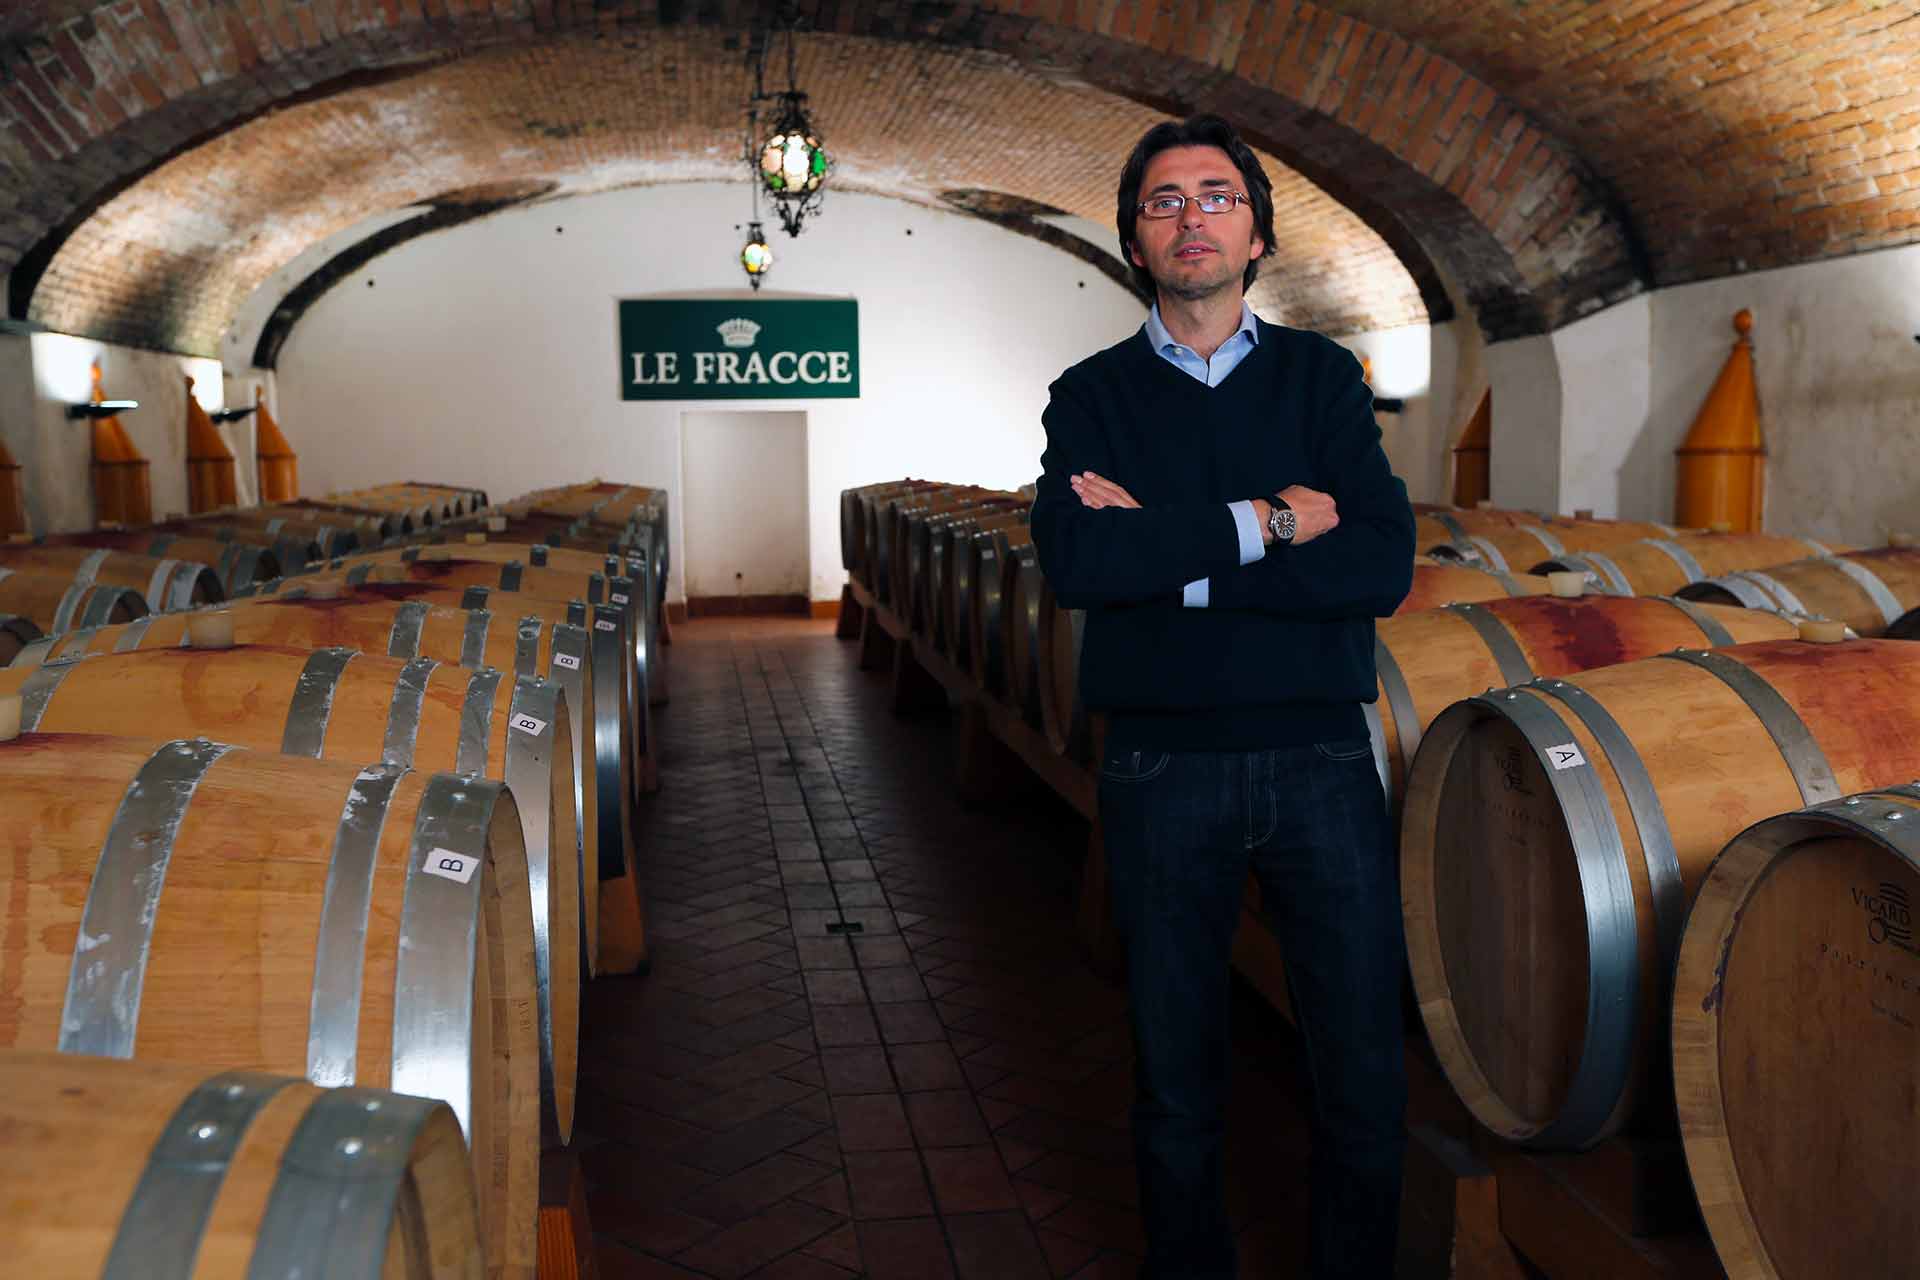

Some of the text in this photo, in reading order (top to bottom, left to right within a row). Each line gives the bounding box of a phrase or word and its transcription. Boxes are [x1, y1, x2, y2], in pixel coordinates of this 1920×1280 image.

[632, 351, 853, 385] LE FRACCE
[561, 656, 575, 667] B
[519, 718, 537, 731] B
[1556, 750, 1576, 763] A
[439, 856, 464, 874] B
